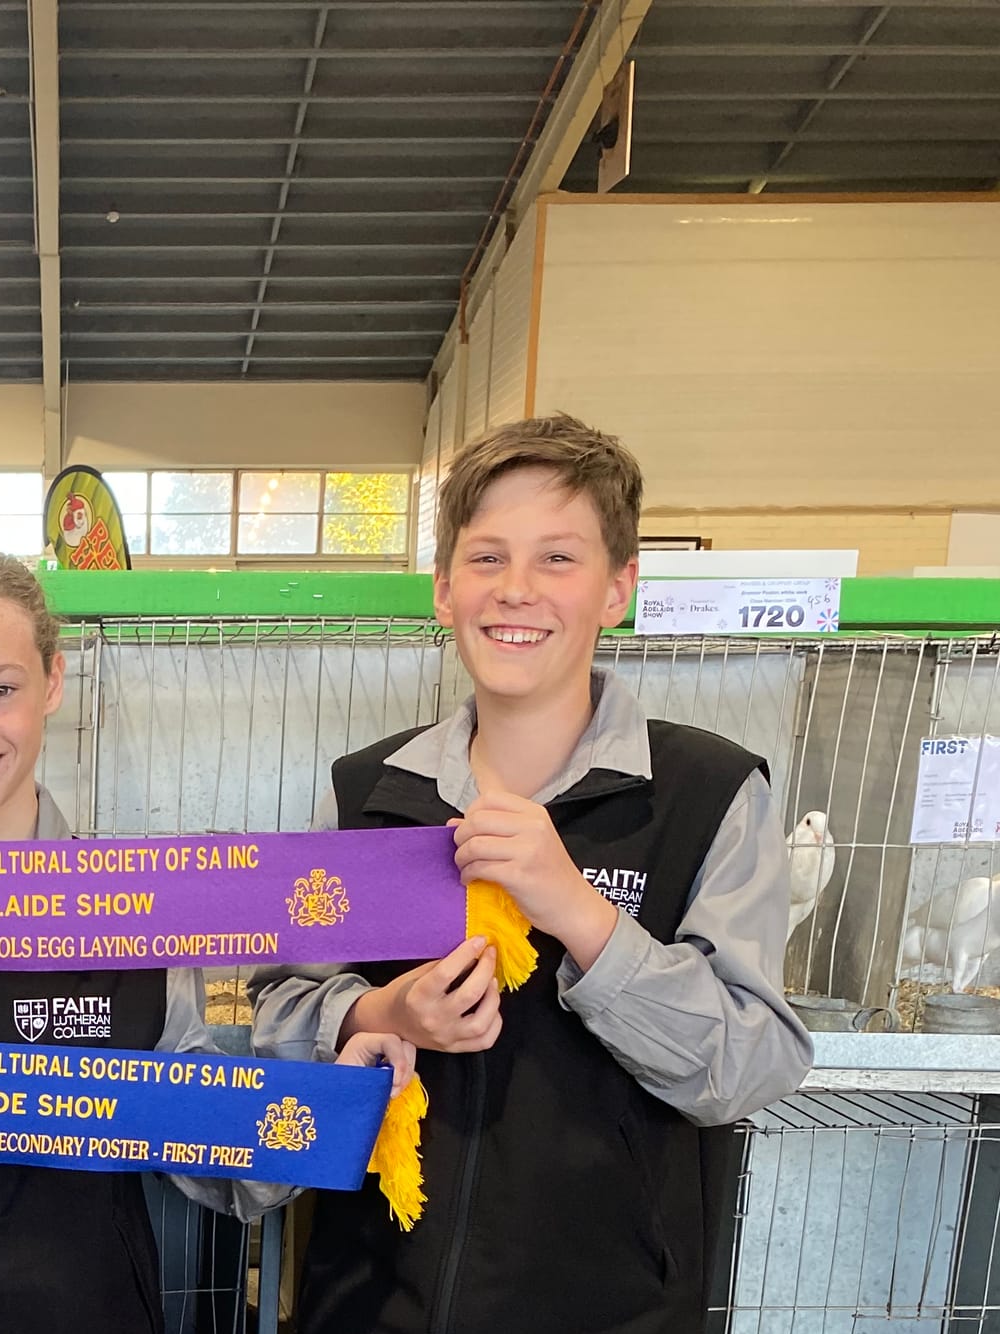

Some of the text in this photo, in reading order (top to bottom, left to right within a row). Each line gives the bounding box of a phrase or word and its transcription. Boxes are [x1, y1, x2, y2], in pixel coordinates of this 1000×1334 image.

[690, 604, 719, 612] Drakes
[739, 605, 805, 627] 1720
[922, 740, 968, 755] FIRST
[76, 847, 160, 874] SOCIETY
[164, 846, 193, 872] OF
[195, 845, 223, 871] SA
[226, 843, 260, 869] INC
[582, 868, 647, 891] FAITH
[75, 891, 155, 917] SHOW
[36, 935, 76, 959] EGG
[79, 935, 148, 958] LAYING
[151, 932, 279, 957] COMPETITION
[52, 996, 111, 1015] FAITH
[53, 1014, 111, 1027] LUTHERAN
[53, 1026, 112, 1039] COLLEGE
[80, 1057, 163, 1081] SOCIETY
[169, 1063, 195, 1084] OF
[201, 1065, 226, 1086] SA
[232, 1068, 265, 1089] INC
[39, 1094, 117, 1119] SHOW
[89, 1138, 149, 1160] POSTER
[163, 1142, 205, 1163] FIRST
[210, 1146, 251, 1167] PRIZE
